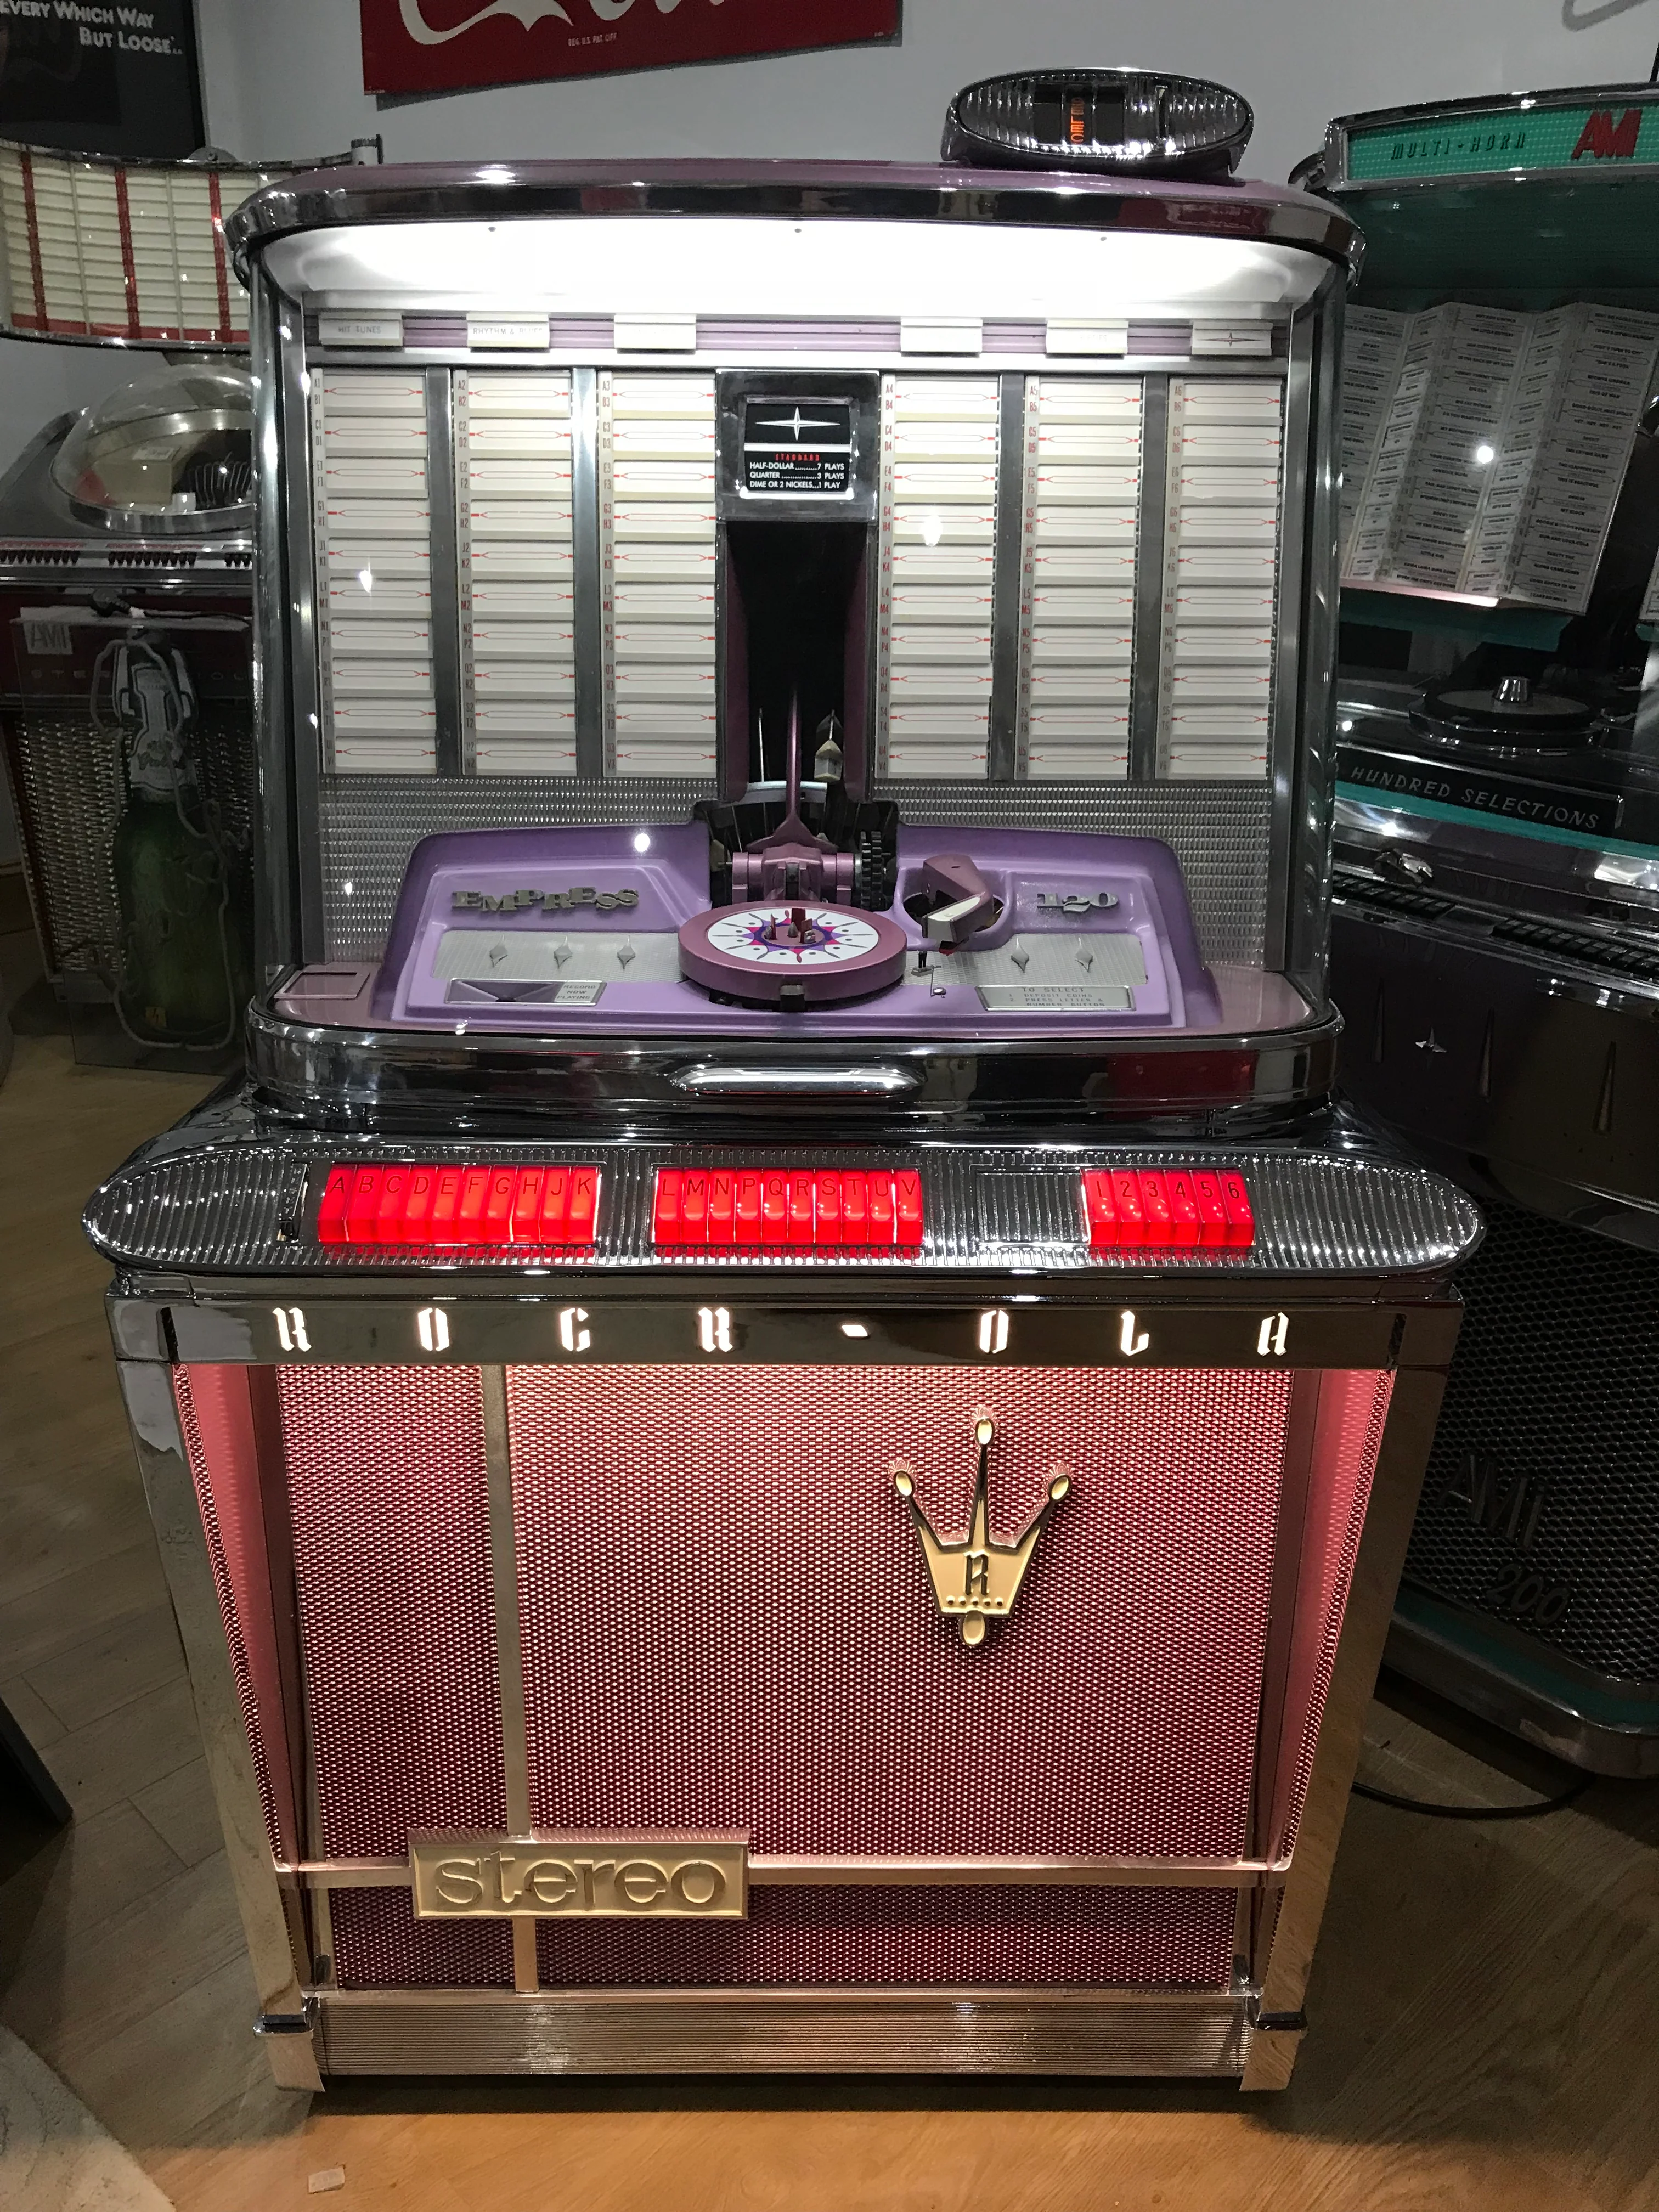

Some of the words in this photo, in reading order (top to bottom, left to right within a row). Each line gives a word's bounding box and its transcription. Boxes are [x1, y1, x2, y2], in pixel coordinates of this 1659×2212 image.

[54, 1, 114, 24] WHICH
[116, 6, 154, 28] WAY
[79, 26, 113, 48] BUT
[314, 378, 320, 388] A1
[458, 380, 465, 390] A2
[602, 381, 610, 391] A3
[886, 384, 893, 393] A4
[314, 394, 320, 404] B1
[459, 396, 466, 406] B2
[603, 396, 610, 407] B3
[886, 400, 893, 410] B4
[315, 420, 321, 430] C1
[459, 421, 466, 432] C2
[603, 422, 610, 432] C3
[885, 425, 892, 435] C4
[316, 436, 321, 445] D1
[459, 437, 467, 447] D2
[603, 438, 611, 448] D3
[885, 441, 892, 451] D4
[317, 460, 323, 471] E1
[460, 461, 467, 472] E2
[603, 462, 611, 473] E3
[885, 466, 891, 476] E4
[318, 477, 323, 486] F1
[461, 478, 468, 489] F2
[604, 479, 611, 489] F3
[884, 482, 891, 492] F4
[318, 500, 324, 510] G1
[461, 503, 468, 512] G2
[604, 503, 611, 514] G3
[884, 506, 891, 516] G4
[318, 516, 324, 526] H1
[461, 518, 468, 528] H2
[604, 519, 611, 529] H3
[883, 522, 890, 532] H4
[320, 540, 325, 551] J1
[463, 542, 470, 552] J2
[605, 544, 612, 554] J3
[883, 546, 890, 557] J4
[1351, 766, 1451, 798] HUNDRED
[1460, 788, 1600, 830] SELECTIONS
[452, 886, 639, 912] EMPRESS
[1037, 892, 1119, 913] 120
[330, 1176, 345, 1194] A
[358, 1175, 374, 1193] B
[386, 1175, 402, 1193] C
[414, 1176, 429, 1194] D
[441, 1176, 457, 1194] E
[468, 1176, 483, 1193] F
[495, 1177, 510, 1194] G
[523, 1177, 539, 1194] H
[551, 1178, 563, 1195] J
[578, 1177, 591, 1195] K
[662, 1178, 675, 1196] L
[687, 1178, 704, 1196] M
[715, 1178, 729, 1195] N
[743, 1177, 755, 1195] P
[769, 1178, 784, 1196] Q
[796, 1178, 809, 1196] R
[821, 1178, 836, 1195] S
[847, 1178, 861, 1195] T
[874, 1180, 888, 1197] U
[901, 1179, 916, 1195] V
[1097, 1180, 1102, 1197] 1
[1120, 1181, 1132, 1198] 2
[1146, 1181, 1159, 1198] 3
[1175, 1181, 1186, 1198] 4
[1200, 1181, 1213, 1198] 5
[1228, 1182, 1240, 1199] 6
[963, 1549, 991, 1596] R
[1485, 1562, 1573, 1627] 200
[436, 1849, 726, 1911] stereo
